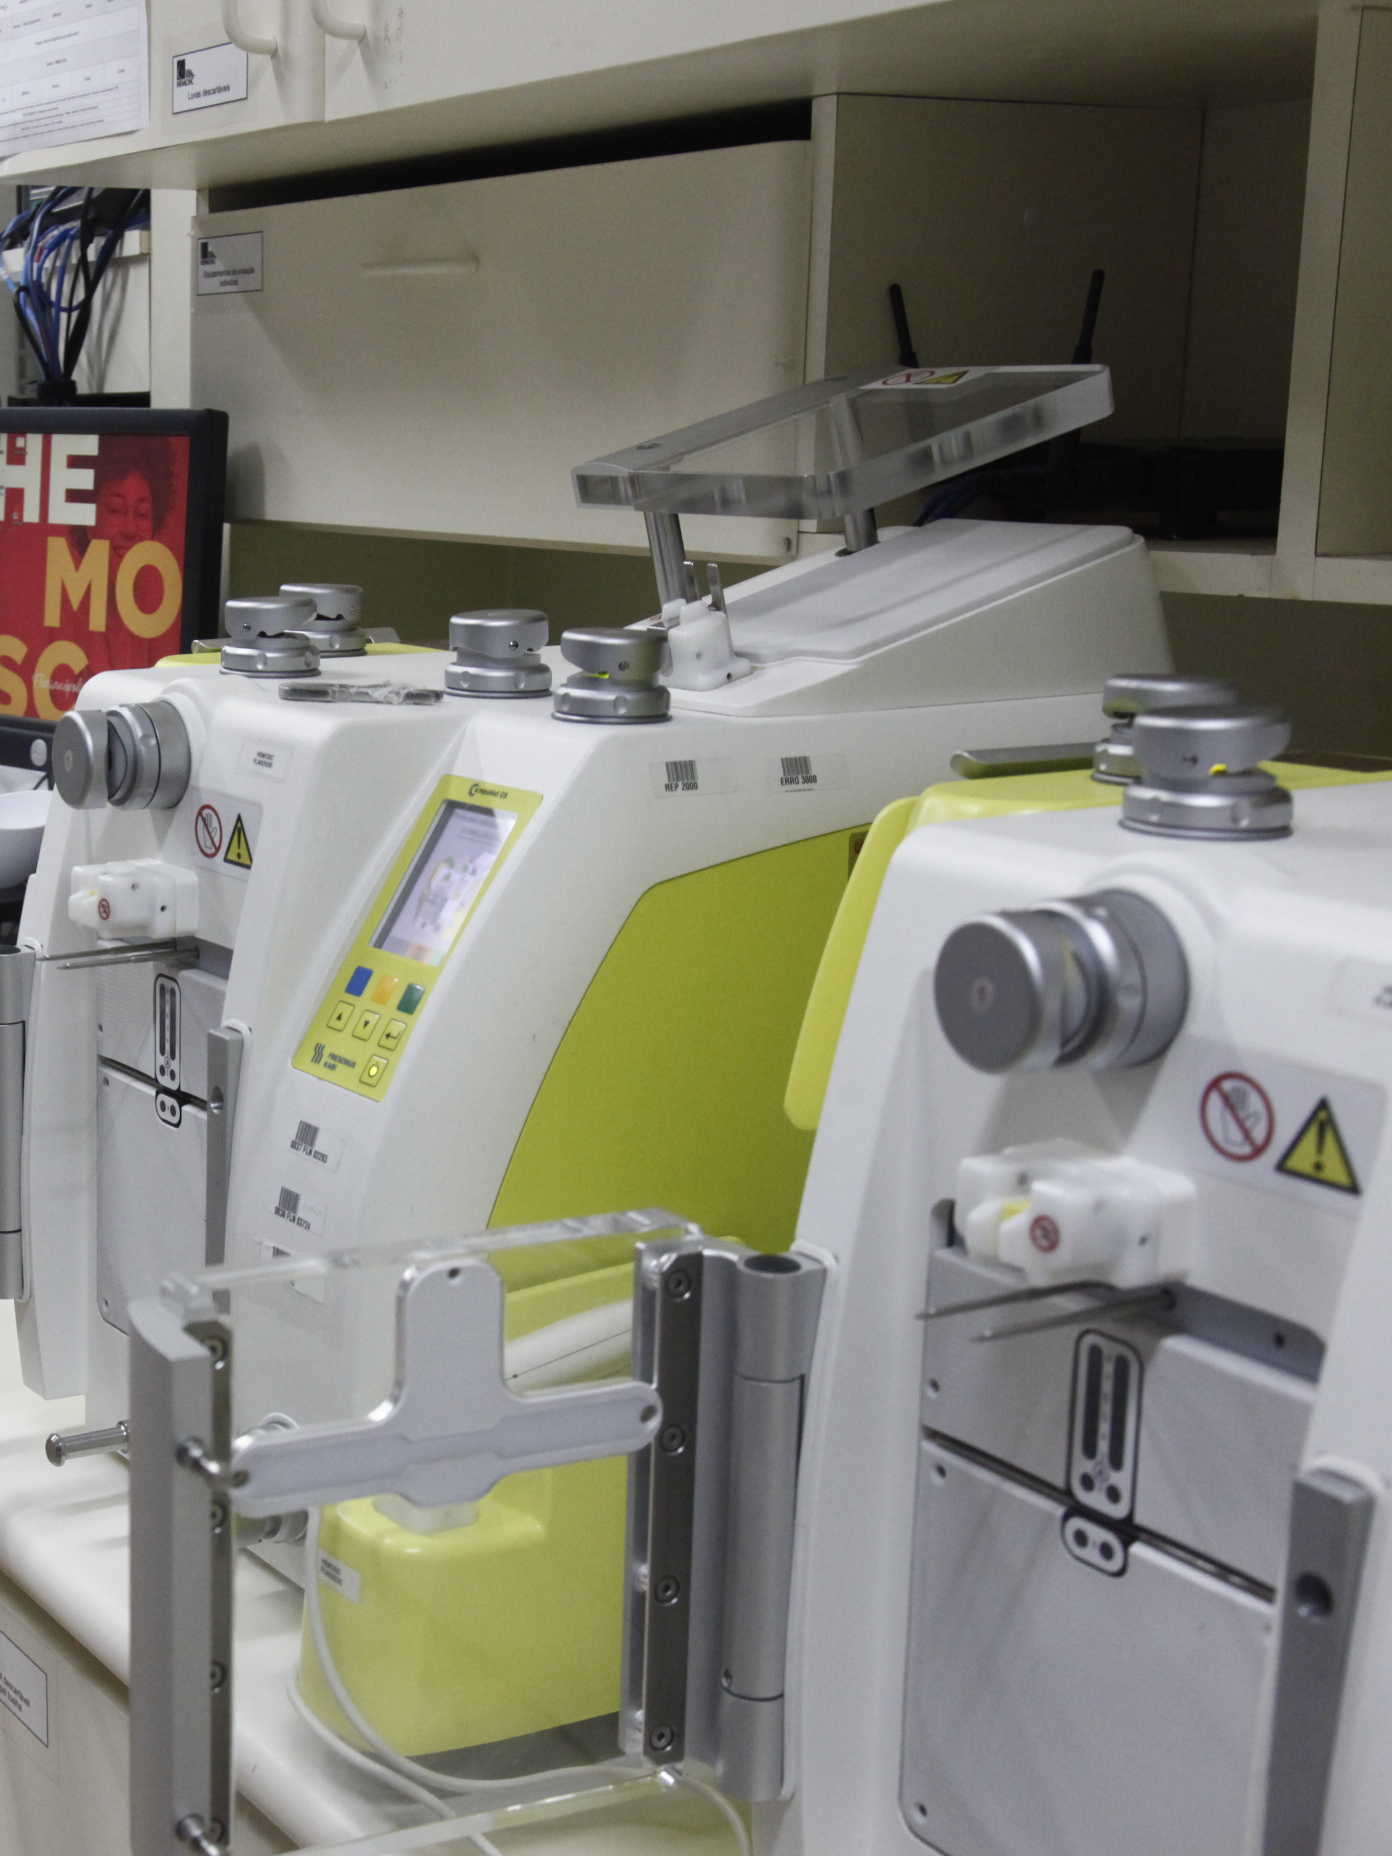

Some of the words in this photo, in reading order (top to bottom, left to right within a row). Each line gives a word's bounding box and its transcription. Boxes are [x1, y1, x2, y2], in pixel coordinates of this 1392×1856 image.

[188, 91, 202, 100] Luvas
[202, 83, 231, 97] descartáveis
[43, 535, 184, 640] MO
[664, 783, 680, 793] REP
[681, 781, 699, 791] 2000
[780, 776, 800, 786] ERRO
[801, 774, 818, 785] 3000
[323, 1060, 337, 1071] KABI
[328, 1052, 357, 1069] FRESENIUS
[302, 1144, 313, 1156] FLN
[286, 1211, 297, 1223] FLN
[3, 1676, 31, 1708] descartável
[7, 1690, 23, 1712] toalha
